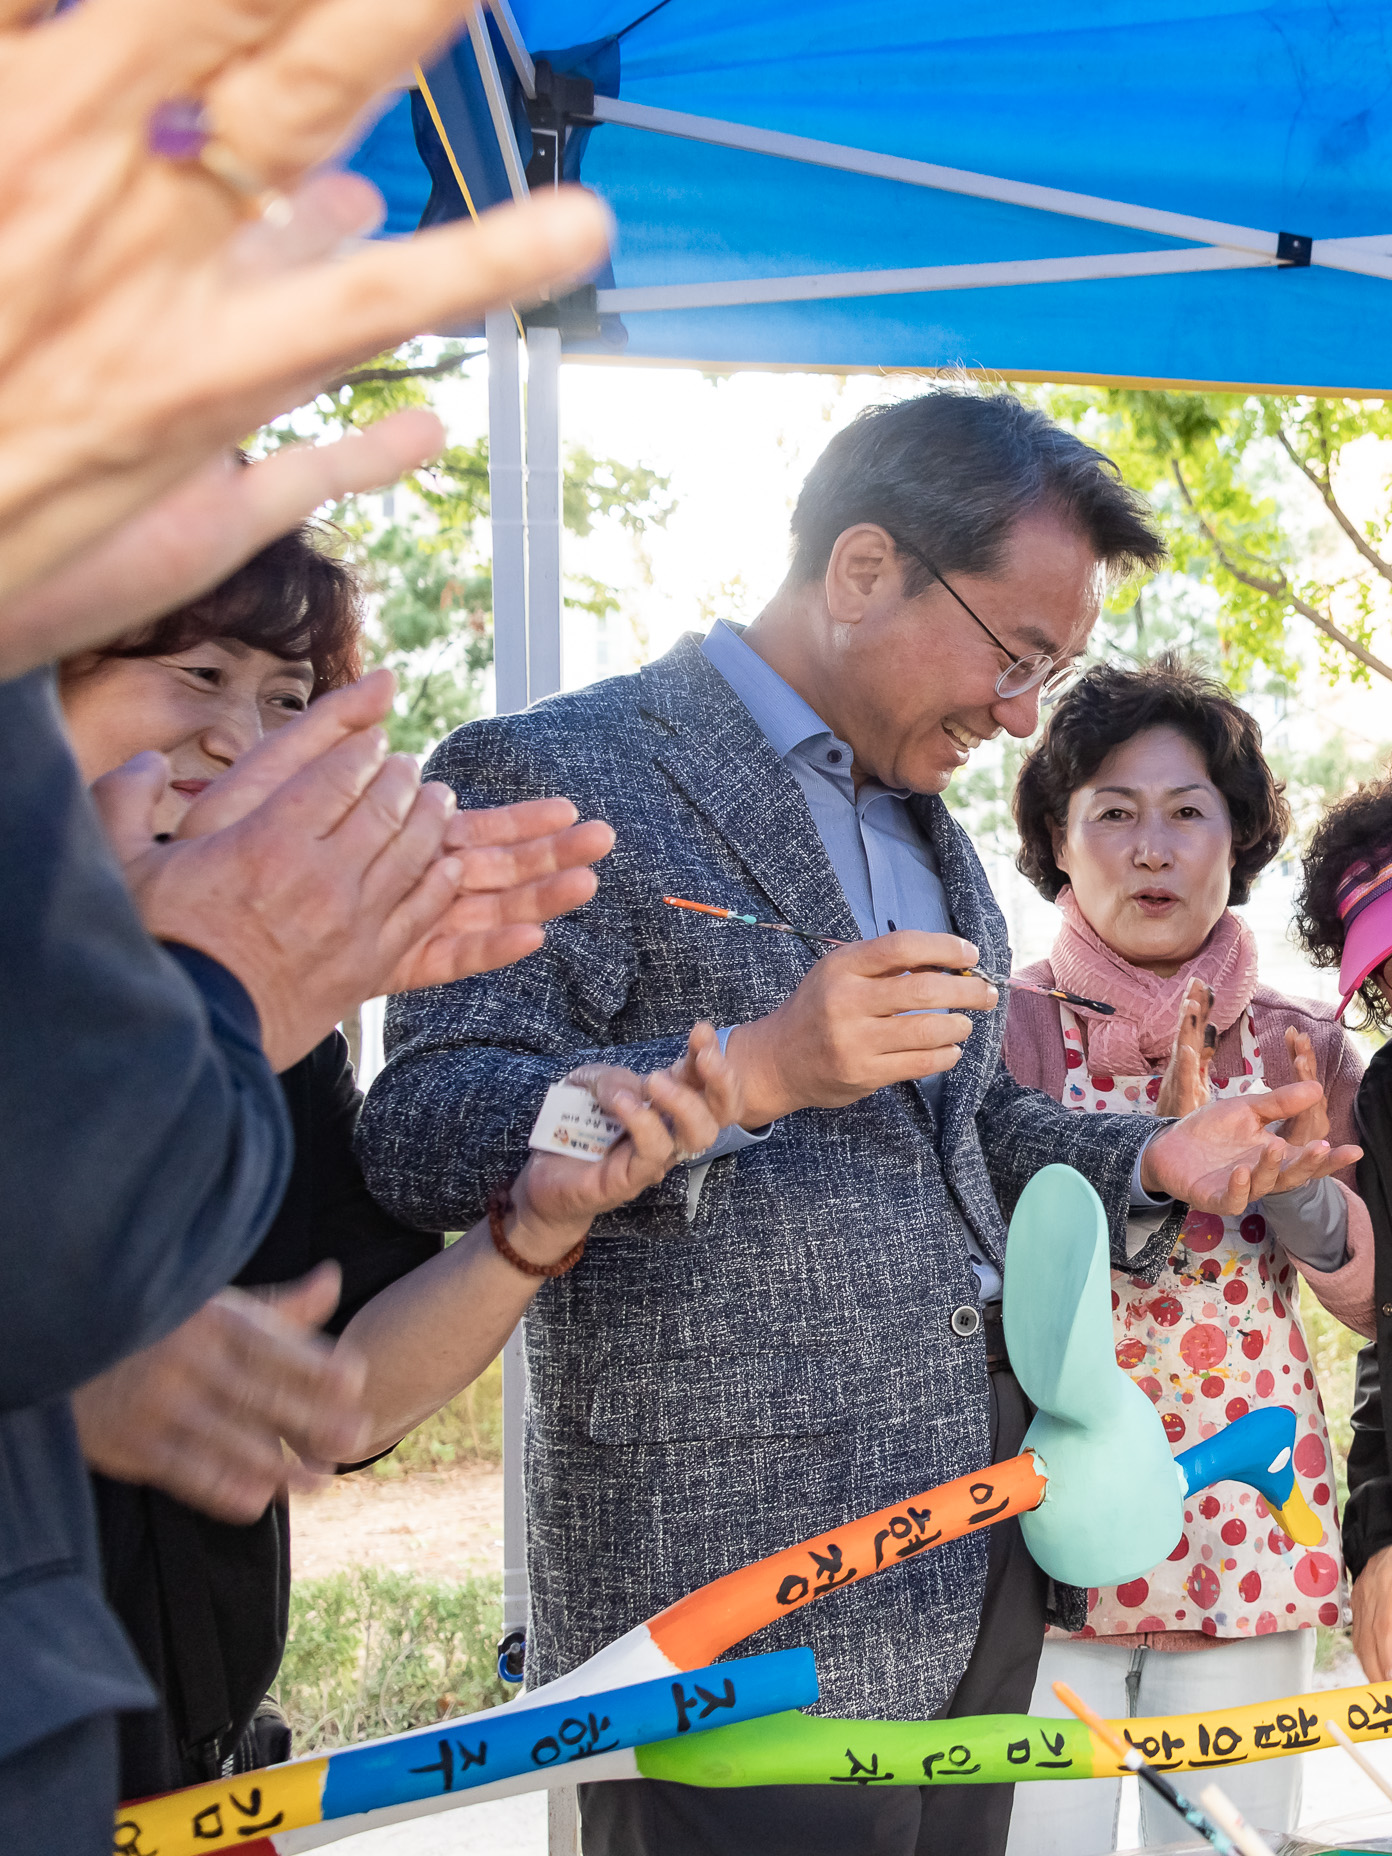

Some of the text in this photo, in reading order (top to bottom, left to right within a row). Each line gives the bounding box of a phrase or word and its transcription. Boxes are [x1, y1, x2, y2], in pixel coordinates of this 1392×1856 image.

[775, 1480, 1011, 1607] 이현정
[410, 1676, 737, 1792] 조형주
[829, 1729, 1073, 1785] 김인자
